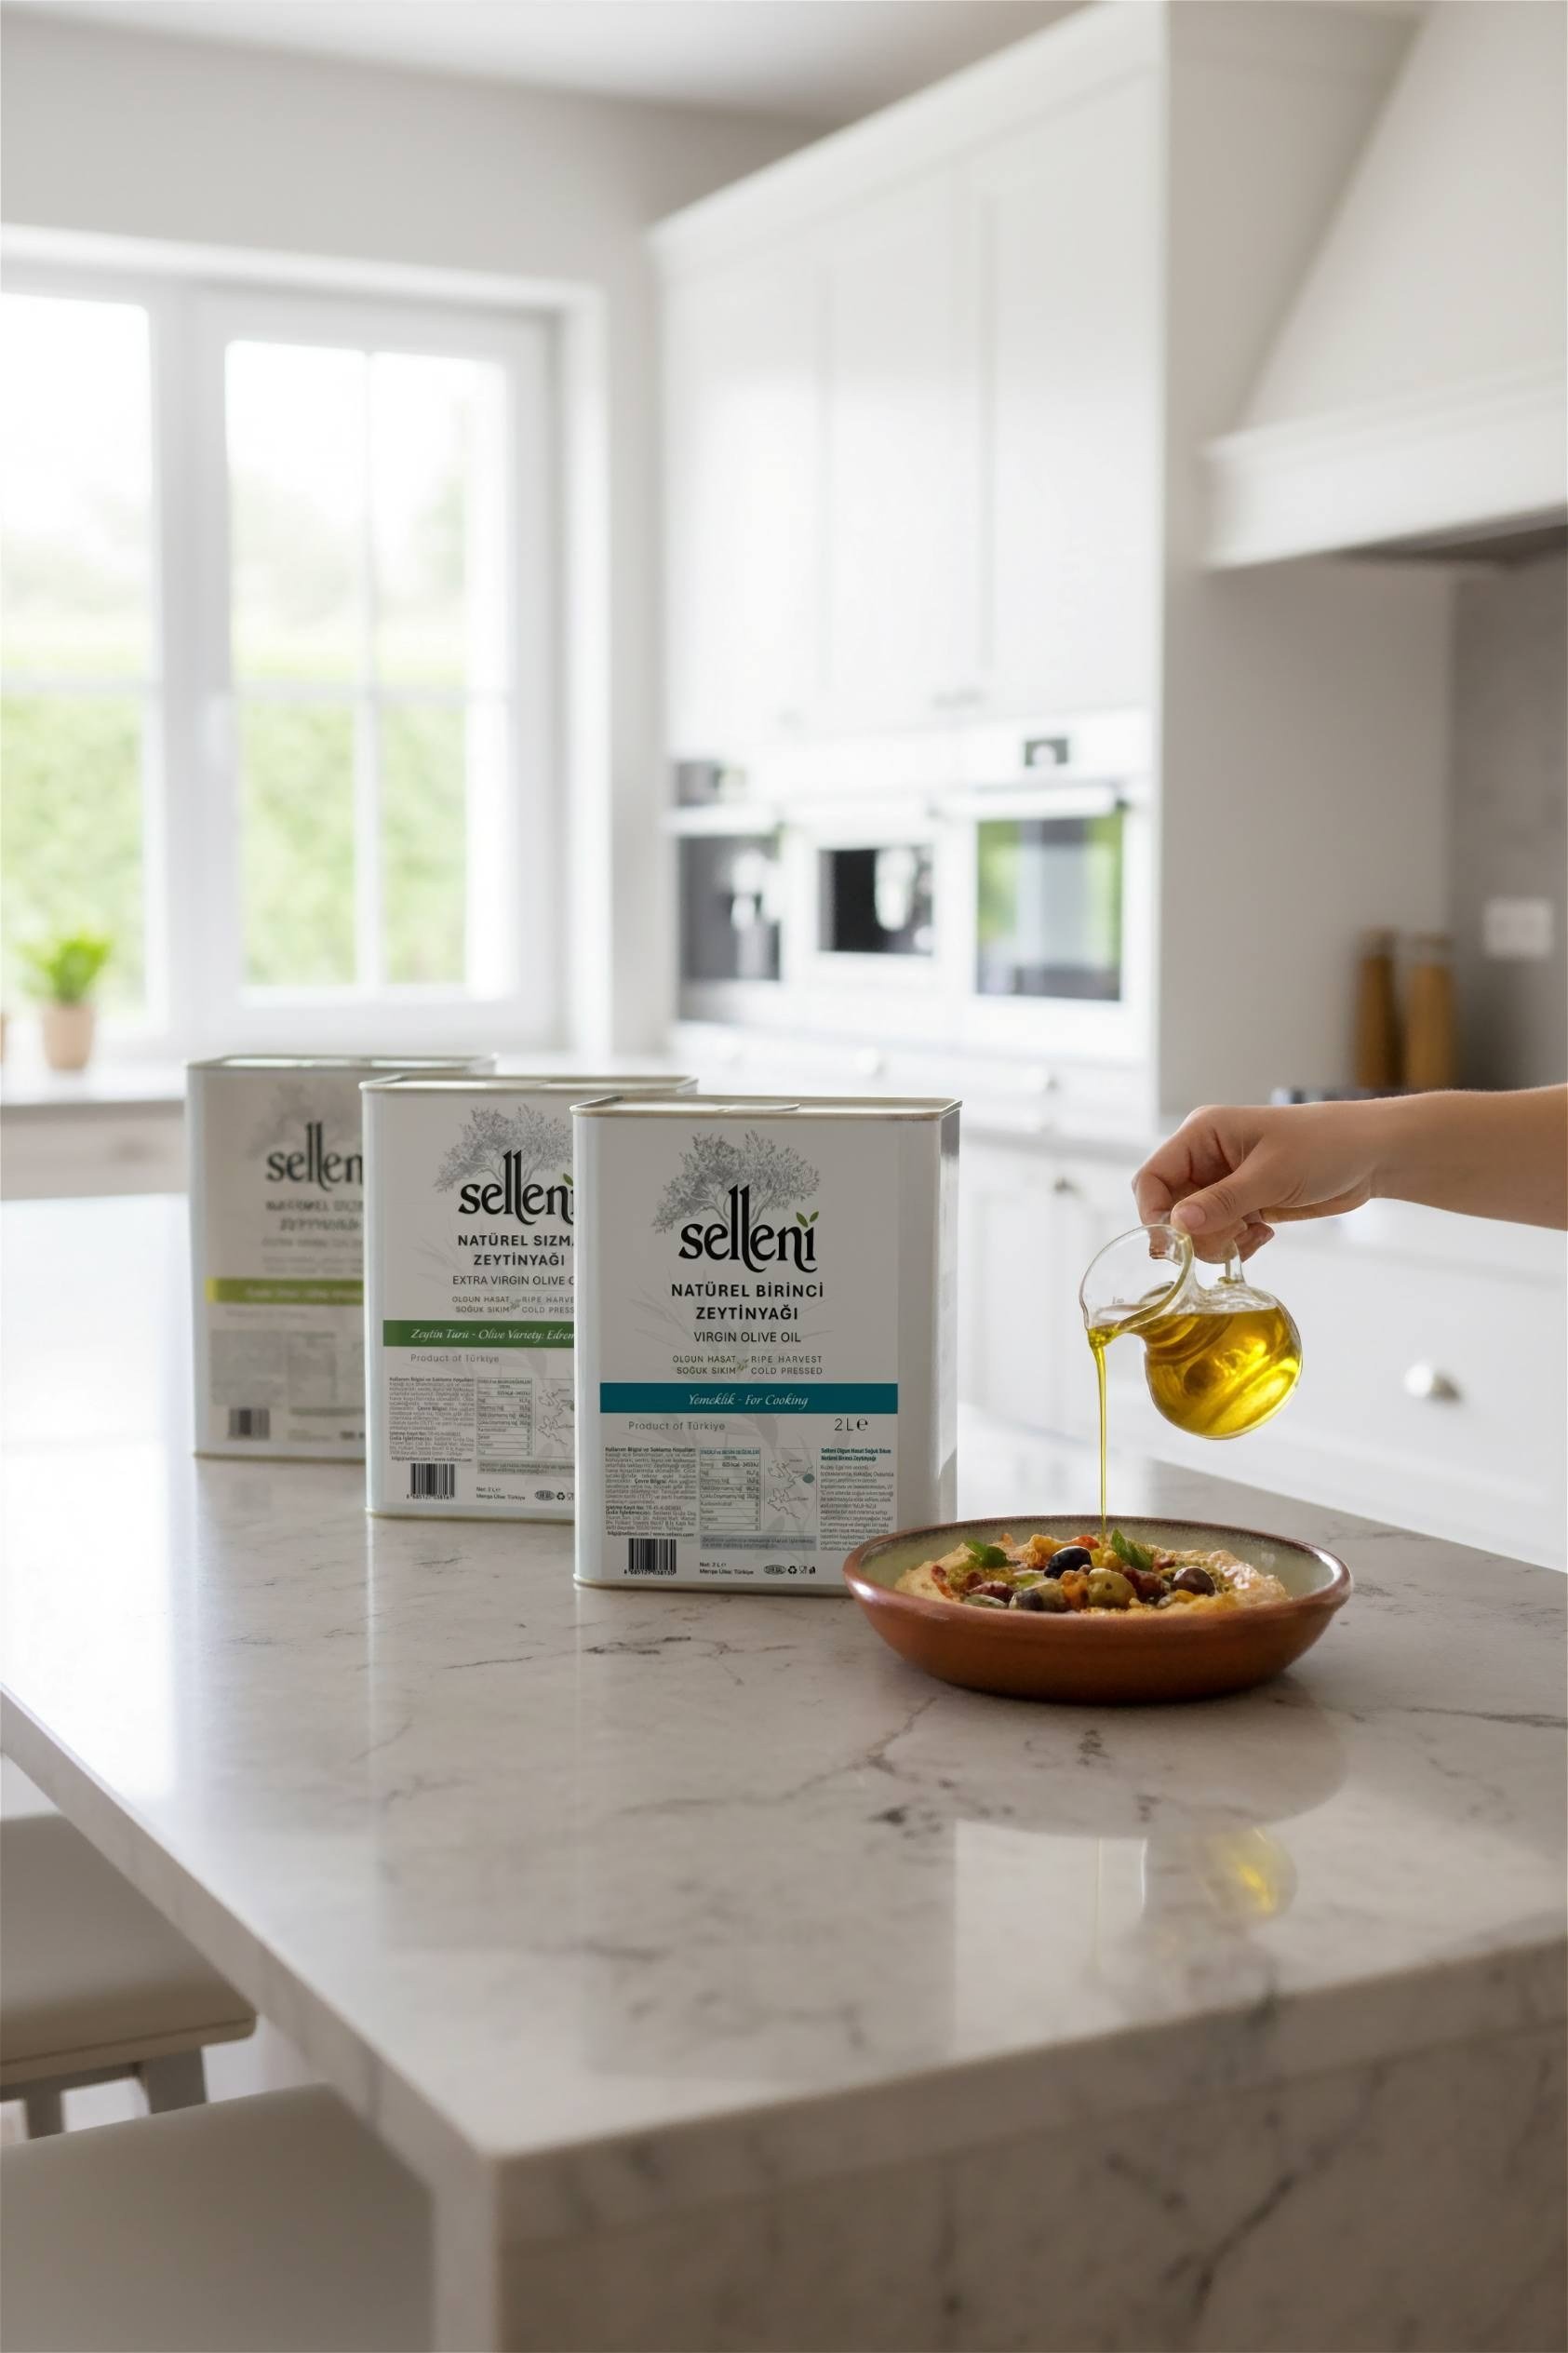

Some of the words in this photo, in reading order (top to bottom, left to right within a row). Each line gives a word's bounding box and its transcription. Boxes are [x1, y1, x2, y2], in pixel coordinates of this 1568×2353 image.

[265, 1122, 362, 1192] sellen
[458, 1150, 573, 1226] sellen
[678, 1184, 819, 1273] selleni
[458, 1232, 528, 1246] NATÜREL
[533, 1235, 573, 1246] SIZM
[474, 1252, 565, 1266] ZEYTİNYAĞI
[452, 1276, 488, 1284] EXTRA
[490, 1276, 529, 1284] VIRGIN
[533, 1276, 565, 1285] OLIVE
[671, 1282, 750, 1298] NATÜREL
[756, 1282, 824, 1298] BİRİNCİ
[695, 1304, 797, 1320] ZEYTİNYAĞI
[410, 1328, 443, 1342] Zeytin
[478, 1328, 505, 1339] Olive
[508, 1329, 544, 1343] Variety:
[547, 1329, 573, 1340] Edrem
[693, 1332, 737, 1342] VIRGIN
[741, 1332, 777, 1342] OLIVE
[780, 1332, 801, 1342] OIL
[410, 1354, 449, 1363] Product
[466, 1353, 500, 1364] Türkiye
[751, 1355, 773, 1364] RIPE
[677, 1365, 707, 1375] SOĞUK
[711, 1366, 736, 1375] SIKIM
[689, 1393, 735, 1405] Yemeklik
[744, 1394, 763, 1405] For
[765, 1393, 809, 1410] Cooking
[628, 1421, 669, 1430] Product
[673, 1421, 683, 1430] of
[688, 1420, 726, 1432] Türkiye
